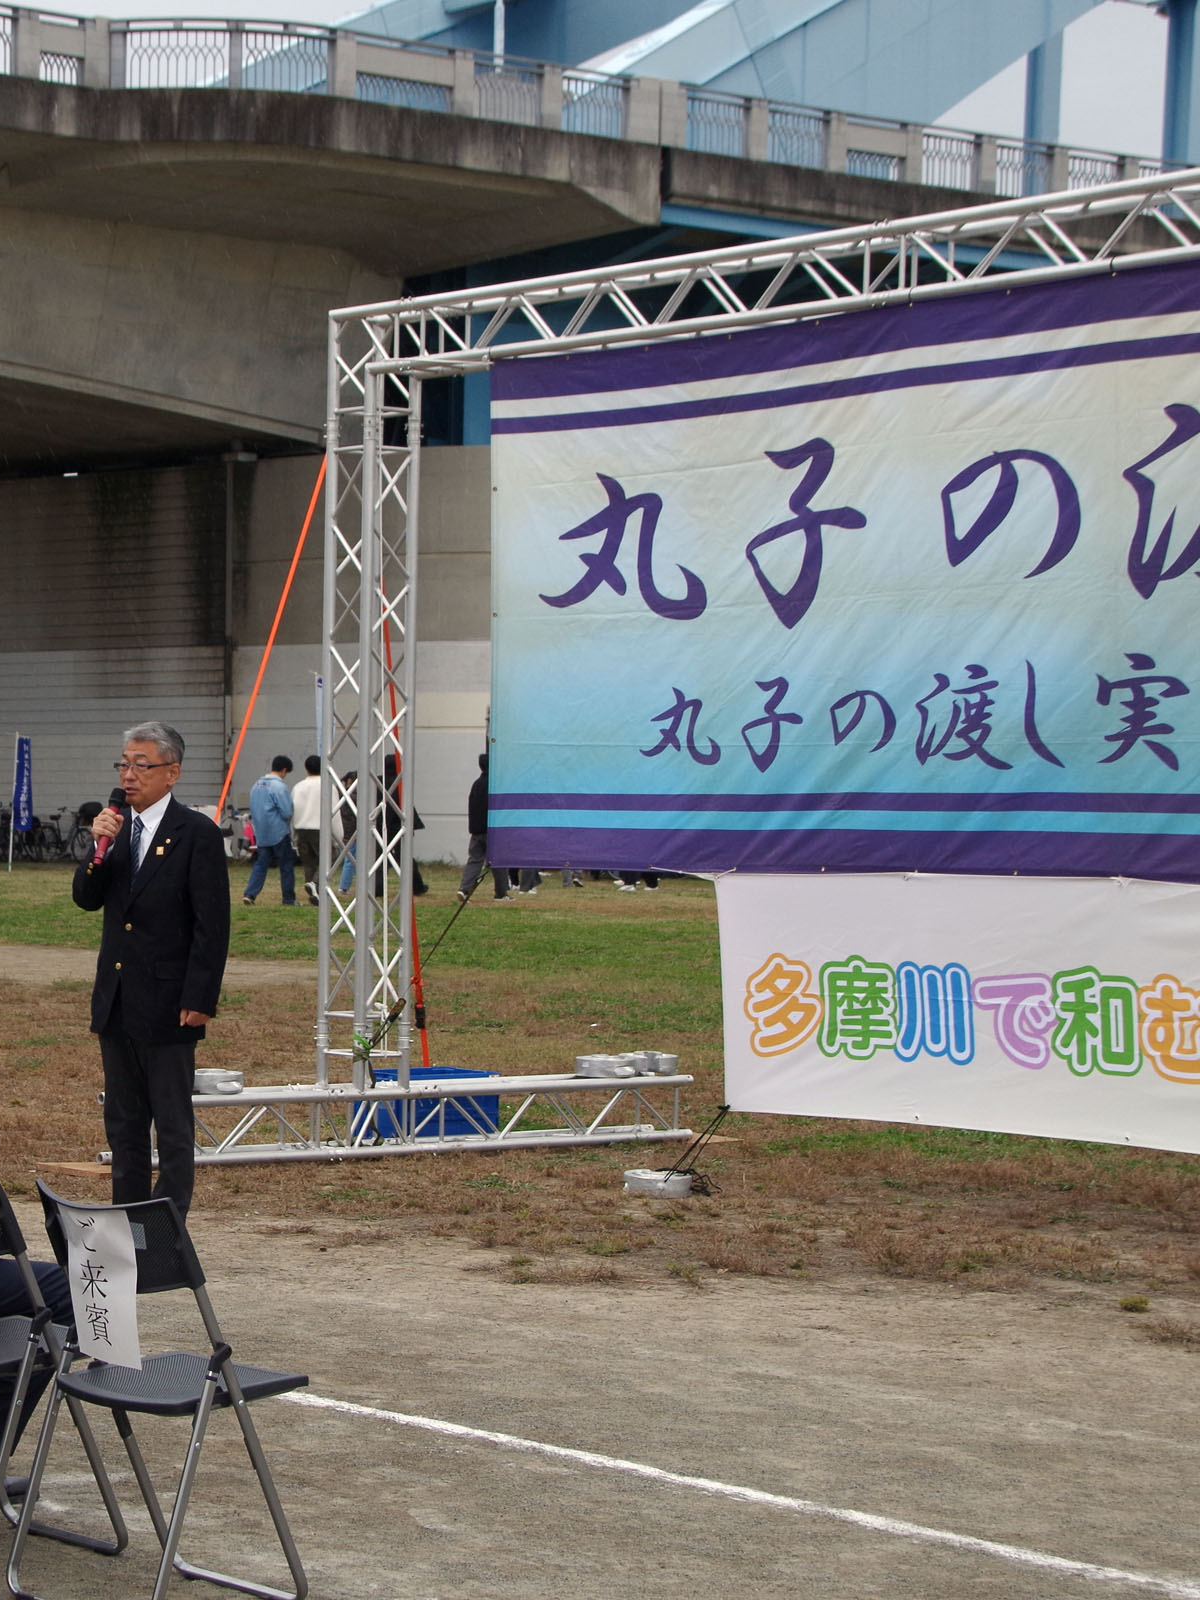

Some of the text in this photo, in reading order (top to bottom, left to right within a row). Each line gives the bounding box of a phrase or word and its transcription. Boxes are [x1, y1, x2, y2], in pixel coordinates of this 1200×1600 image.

[639, 652, 1190, 772] 丸子の渡し実
[76, 1216, 113, 1347] ご来賓
